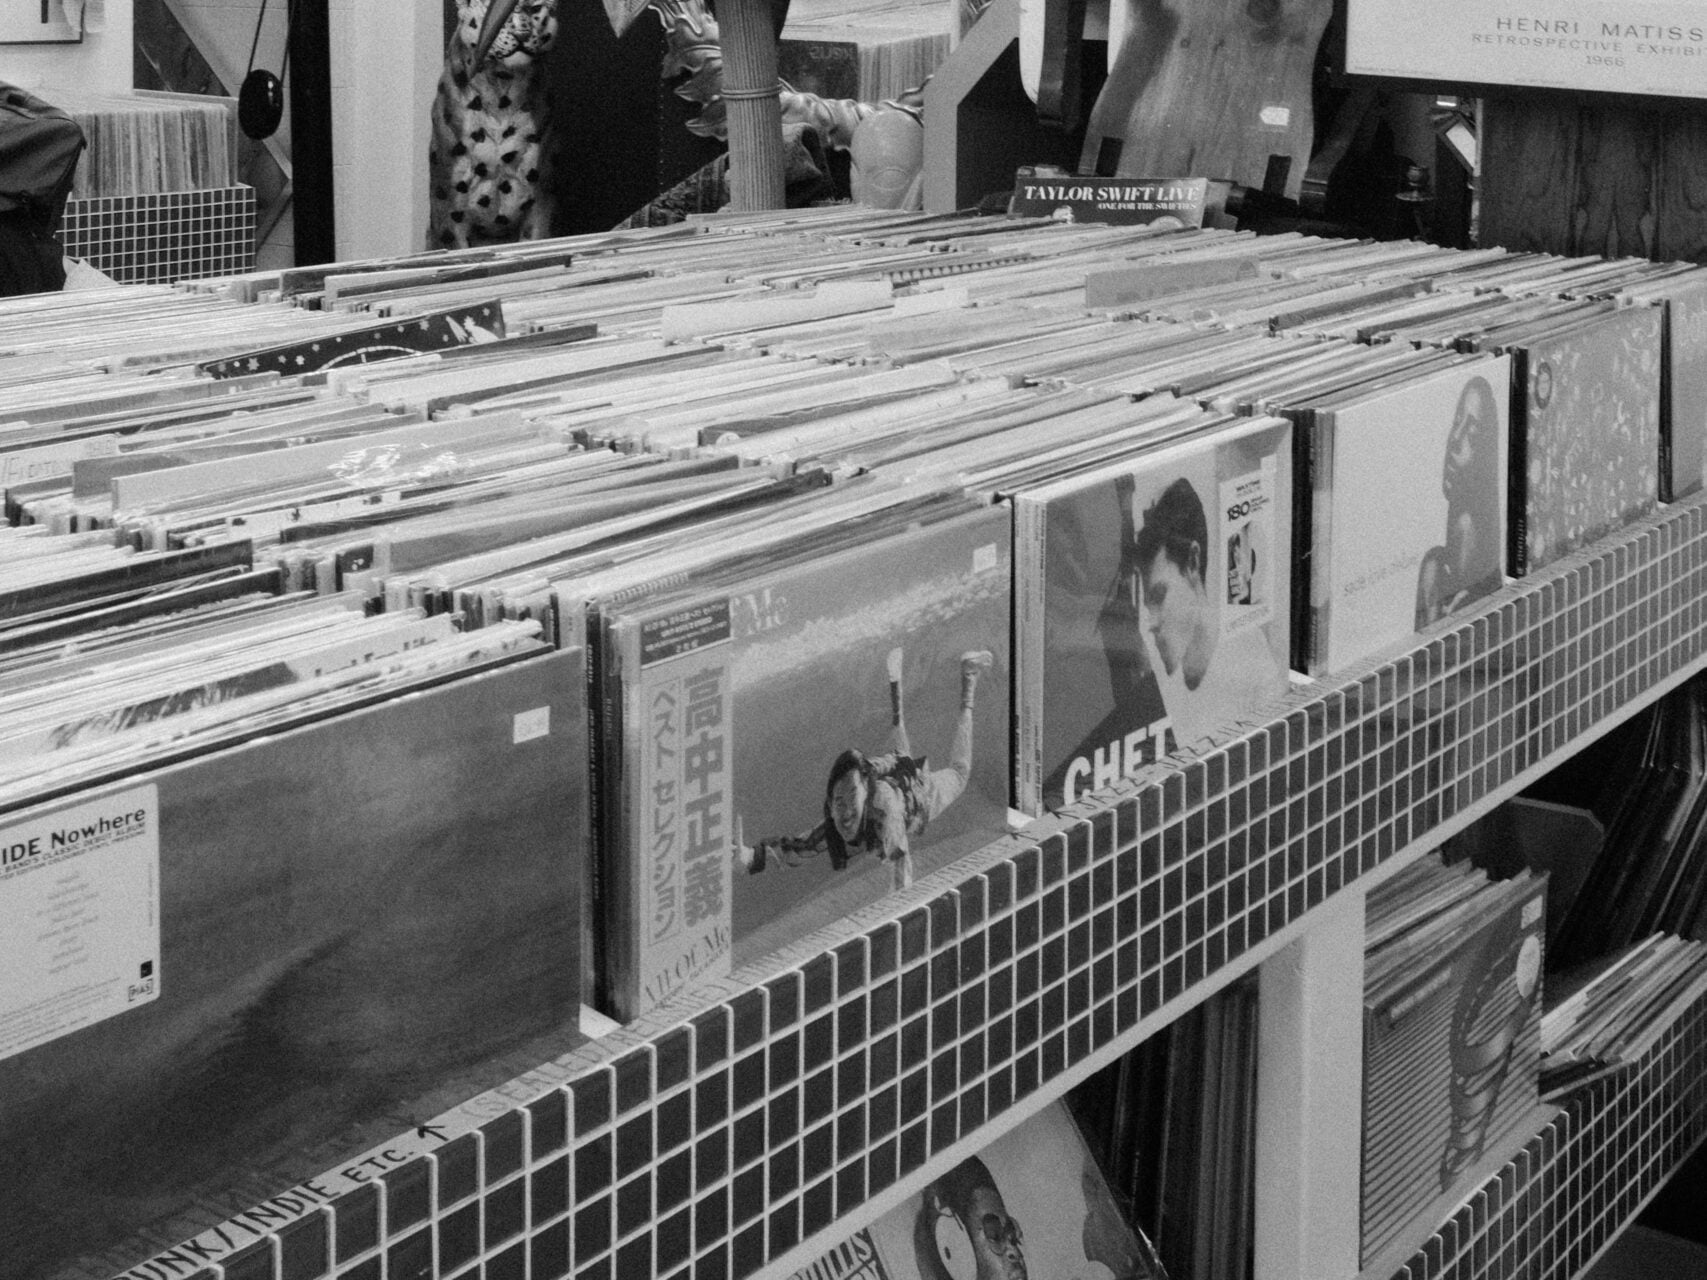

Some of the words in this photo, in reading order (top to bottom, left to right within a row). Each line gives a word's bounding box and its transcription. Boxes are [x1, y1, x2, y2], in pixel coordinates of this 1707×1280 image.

[1496, 18, 1578, 34] HENRI
[1601, 22, 1706, 42] MATISS
[1471, 33, 1623, 53] RETROSPECTIVE
[1636, 42, 1707, 57] EXHIBI
[1586, 55, 1625, 67] 1966
[1024, 185, 1094, 201] TAYLOR
[1096, 185, 1155, 201] SWIFT
[1157, 186, 1200, 201] LIVE
[1227, 501, 1250, 522] 180
[1063, 716, 1172, 810] CHET
[683, 666, 725, 928] 高中正義
[0, 837, 41, 865] IDE
[51, 808, 146, 849] Nowhere
[111, 1179, 341, 1280] UNK/INDIE
[340, 1148, 415, 1184] ETC.
